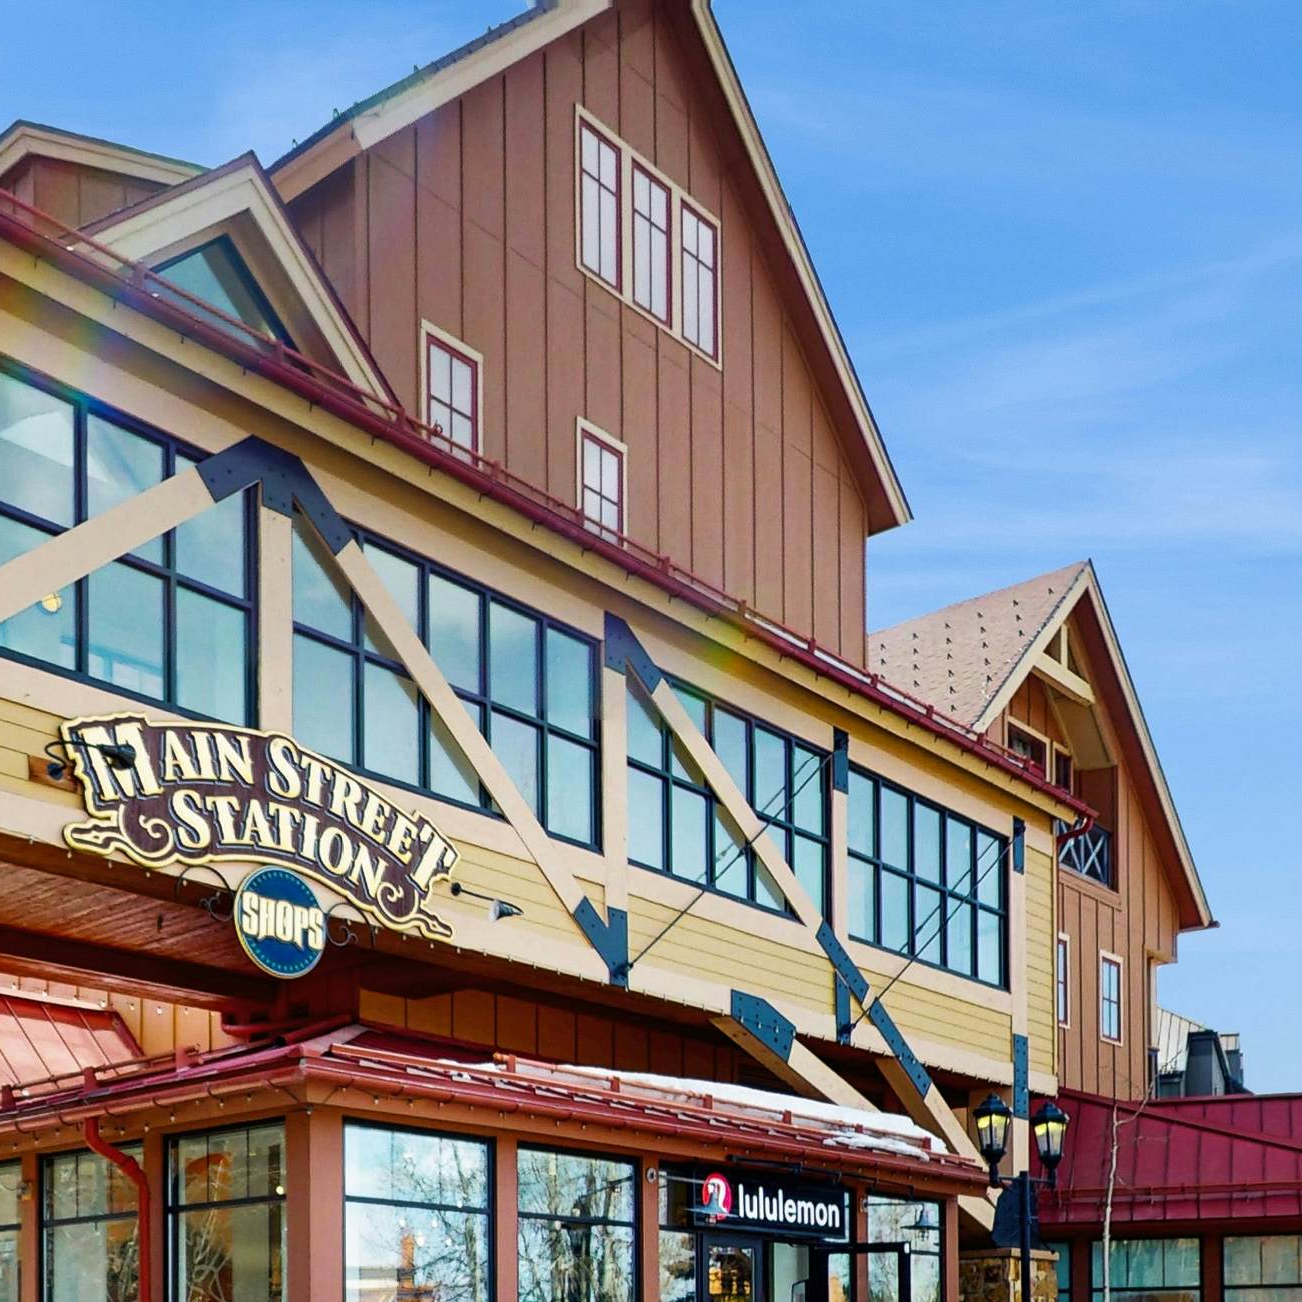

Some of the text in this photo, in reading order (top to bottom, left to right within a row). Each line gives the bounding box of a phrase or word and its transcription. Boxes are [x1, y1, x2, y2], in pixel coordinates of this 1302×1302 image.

[79, 722, 454, 892] MAIN STREET
[171, 789, 388, 900] STATION
[241, 891, 325, 951] SHOPS
[738, 1184, 840, 1228] lululemon
